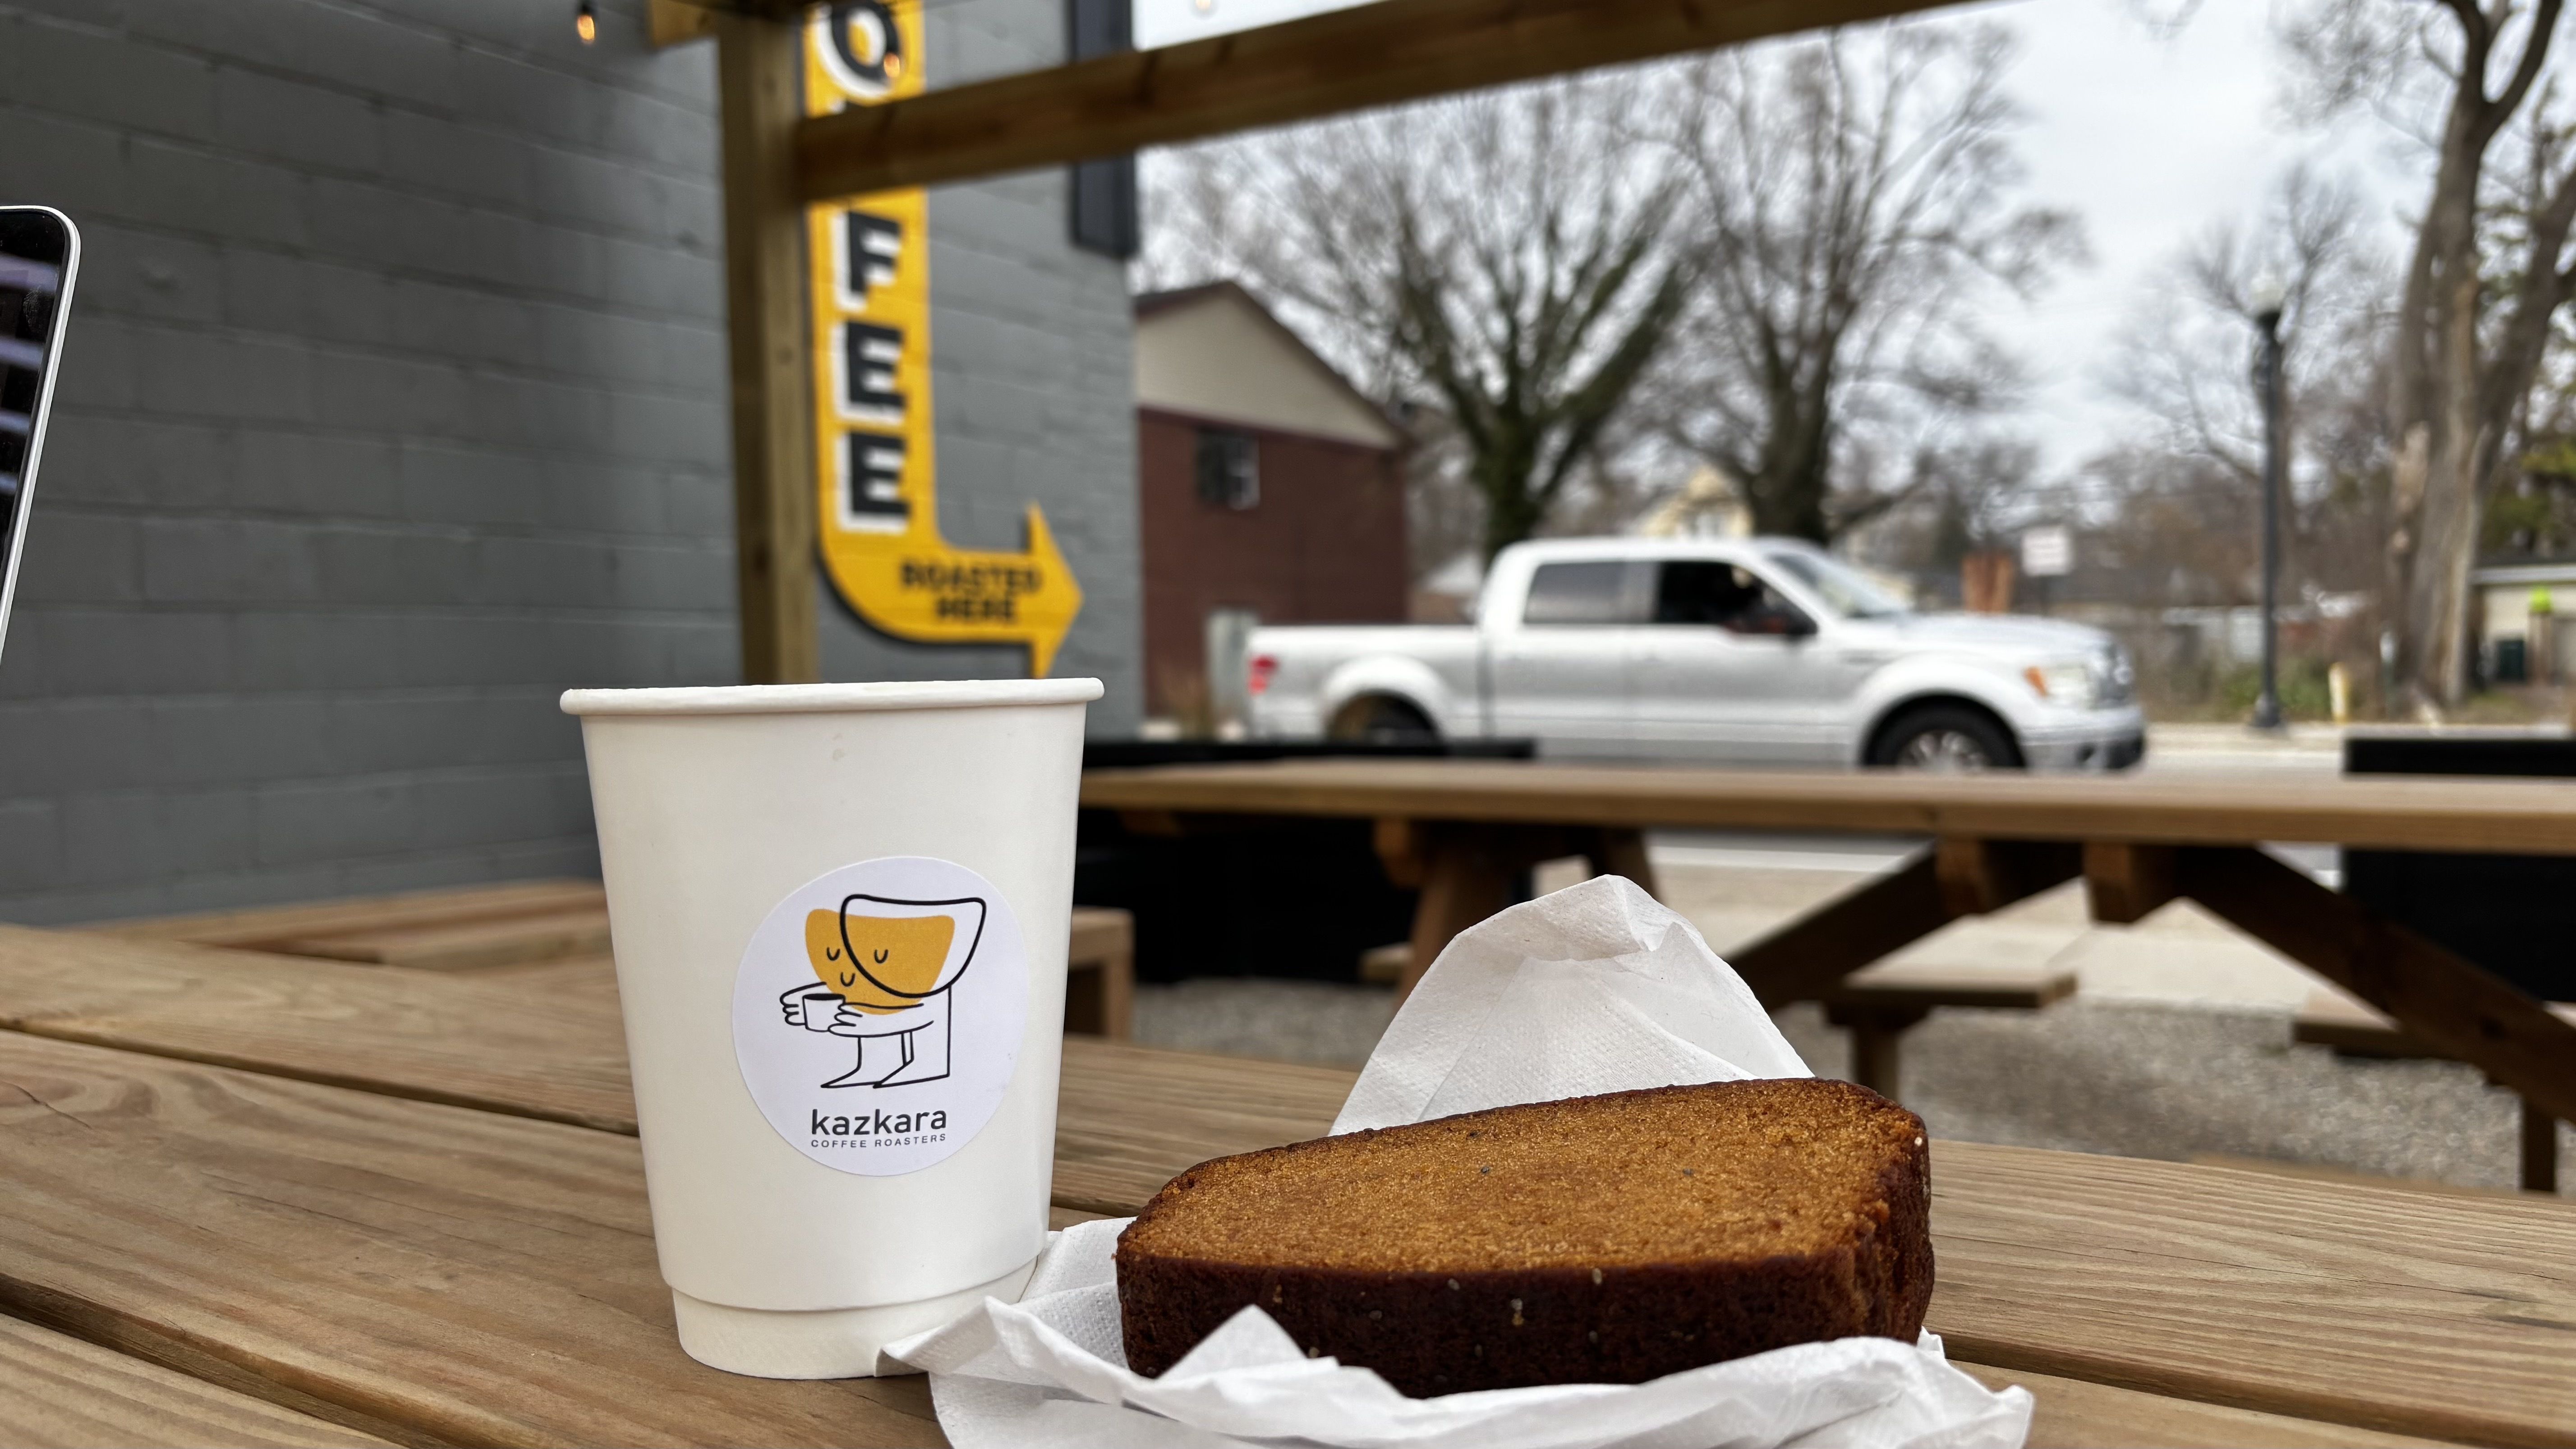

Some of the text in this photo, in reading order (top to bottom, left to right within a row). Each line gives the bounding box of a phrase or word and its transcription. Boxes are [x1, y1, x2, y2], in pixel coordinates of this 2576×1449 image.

[813, 0, 911, 534] OFEE
[935, 596, 1018, 624] HERE
[811, 1109, 947, 1136] kazkara
[811, 1133, 946, 1148] COFFEE ROASTERS
